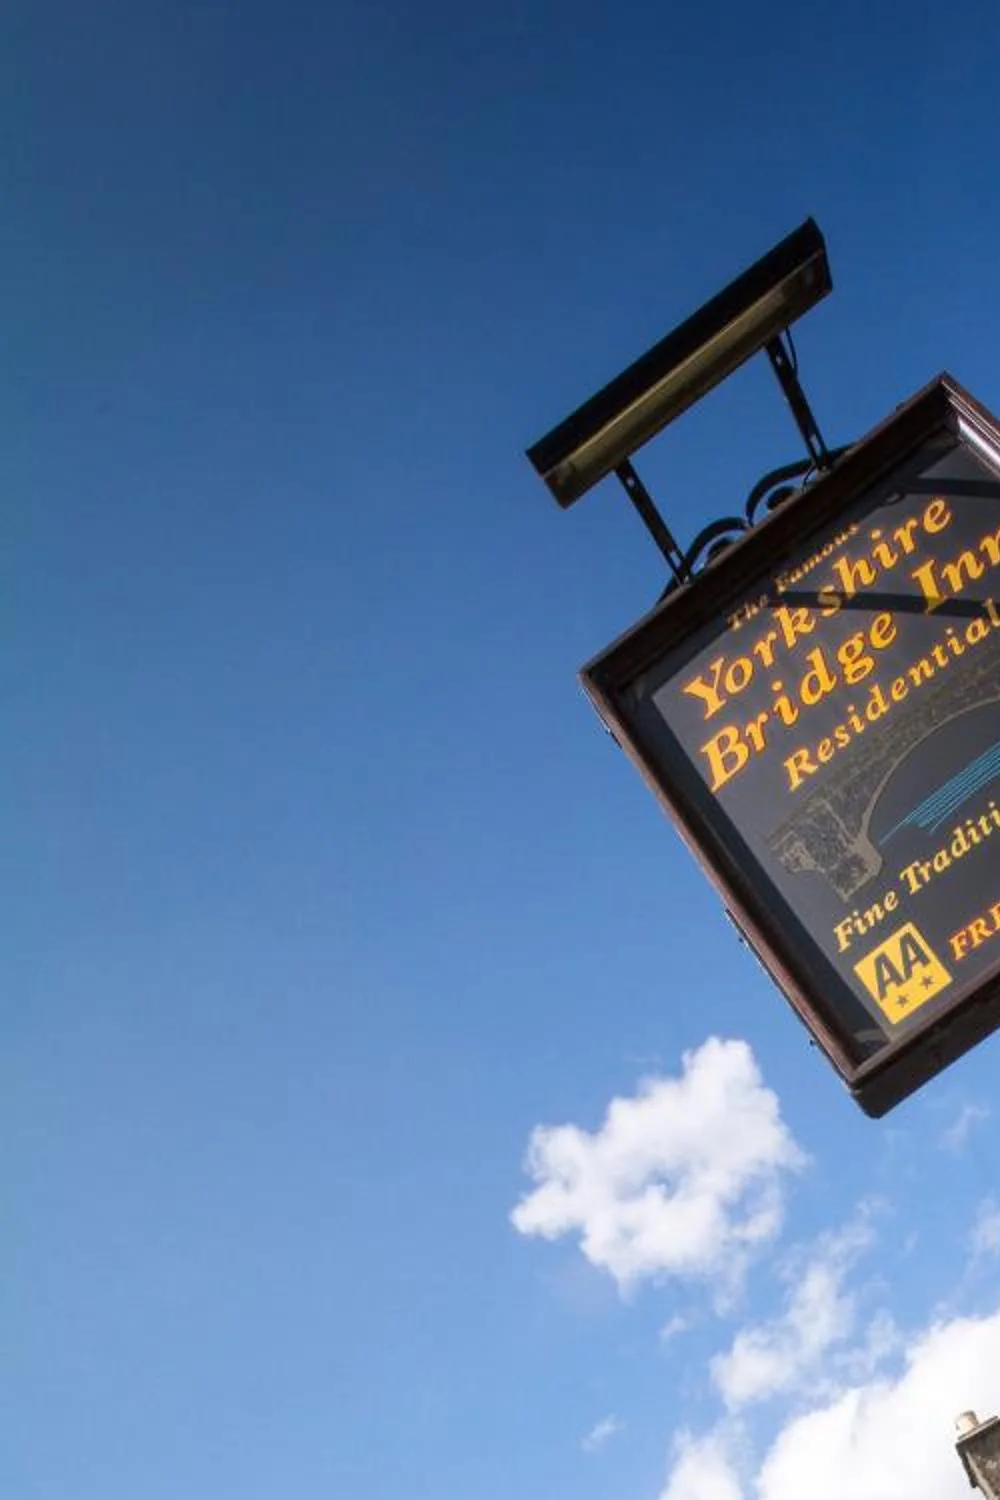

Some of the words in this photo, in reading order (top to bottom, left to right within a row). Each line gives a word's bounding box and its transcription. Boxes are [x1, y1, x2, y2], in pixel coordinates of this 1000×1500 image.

[775, 523, 861, 594] Famous
[682, 496, 952, 719] Yorkshire
[700, 609, 897, 793] Bridge
[833, 892, 899, 953] Fine
[871, 931, 931, 999] AA
